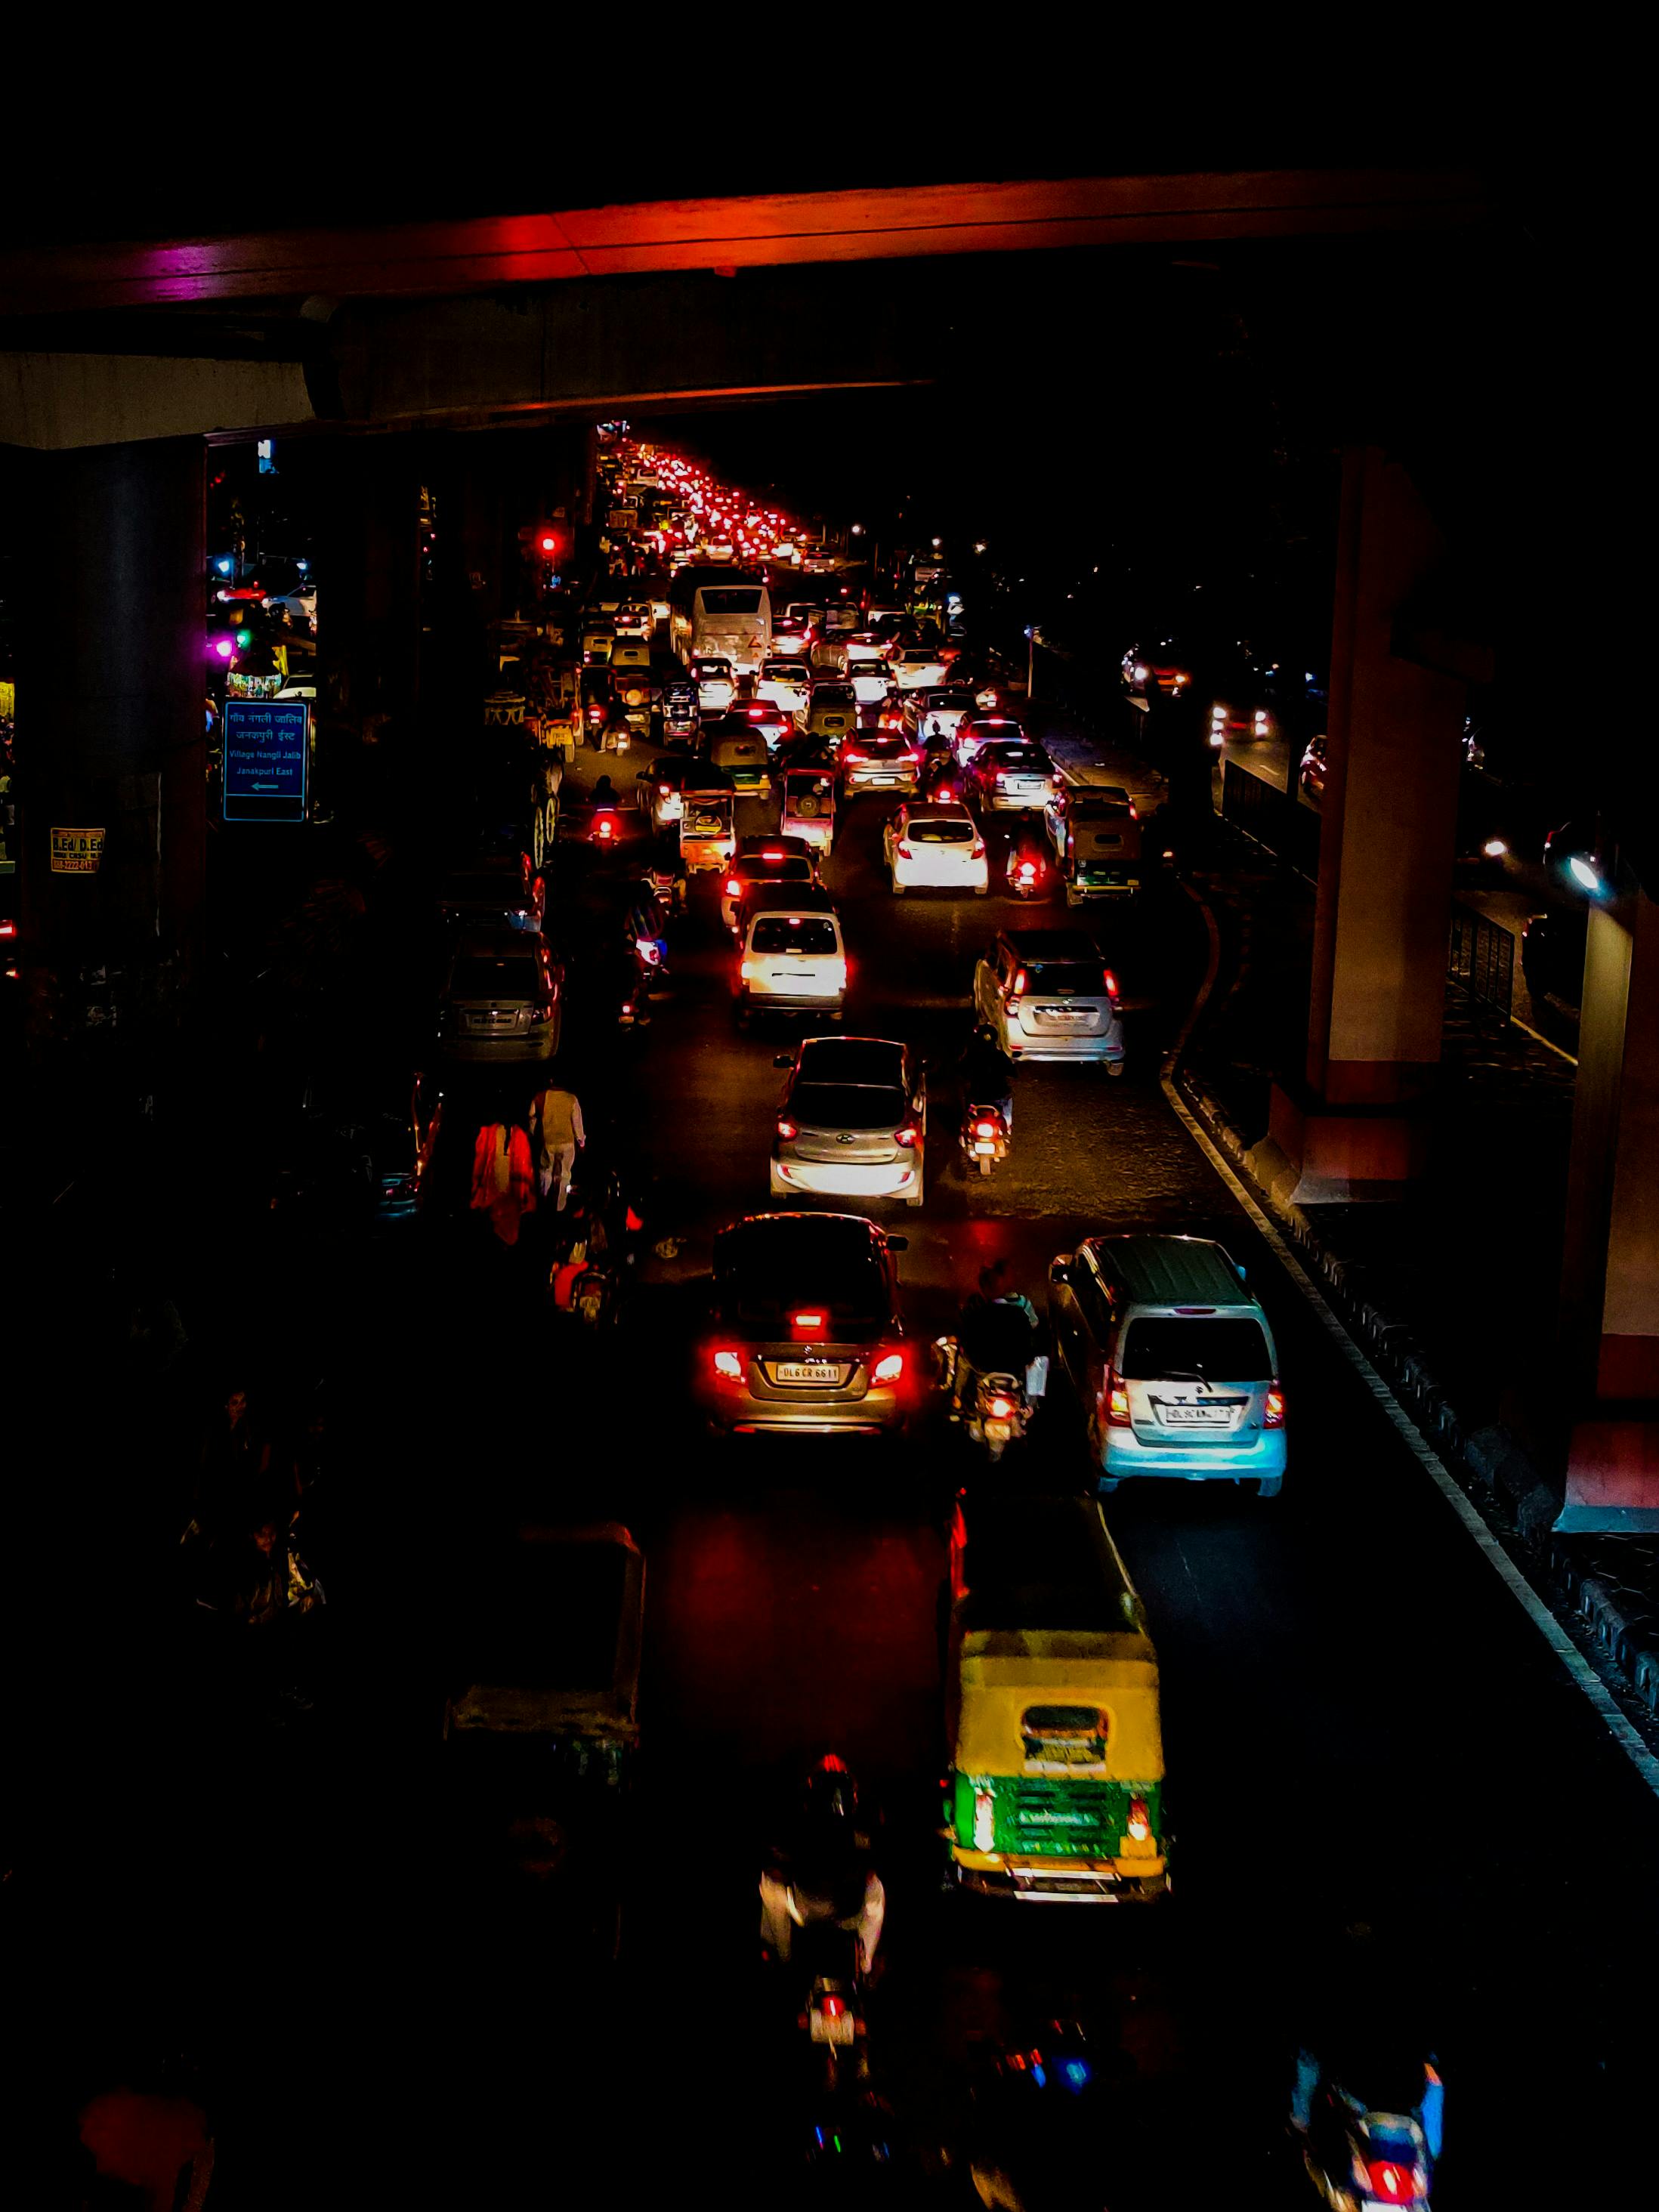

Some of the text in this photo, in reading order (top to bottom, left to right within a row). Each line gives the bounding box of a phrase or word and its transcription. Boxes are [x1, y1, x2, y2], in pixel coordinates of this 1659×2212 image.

[229, 749, 301, 760] Village Nangli Jalib
[236, 767, 293, 777] Janakpuri East
